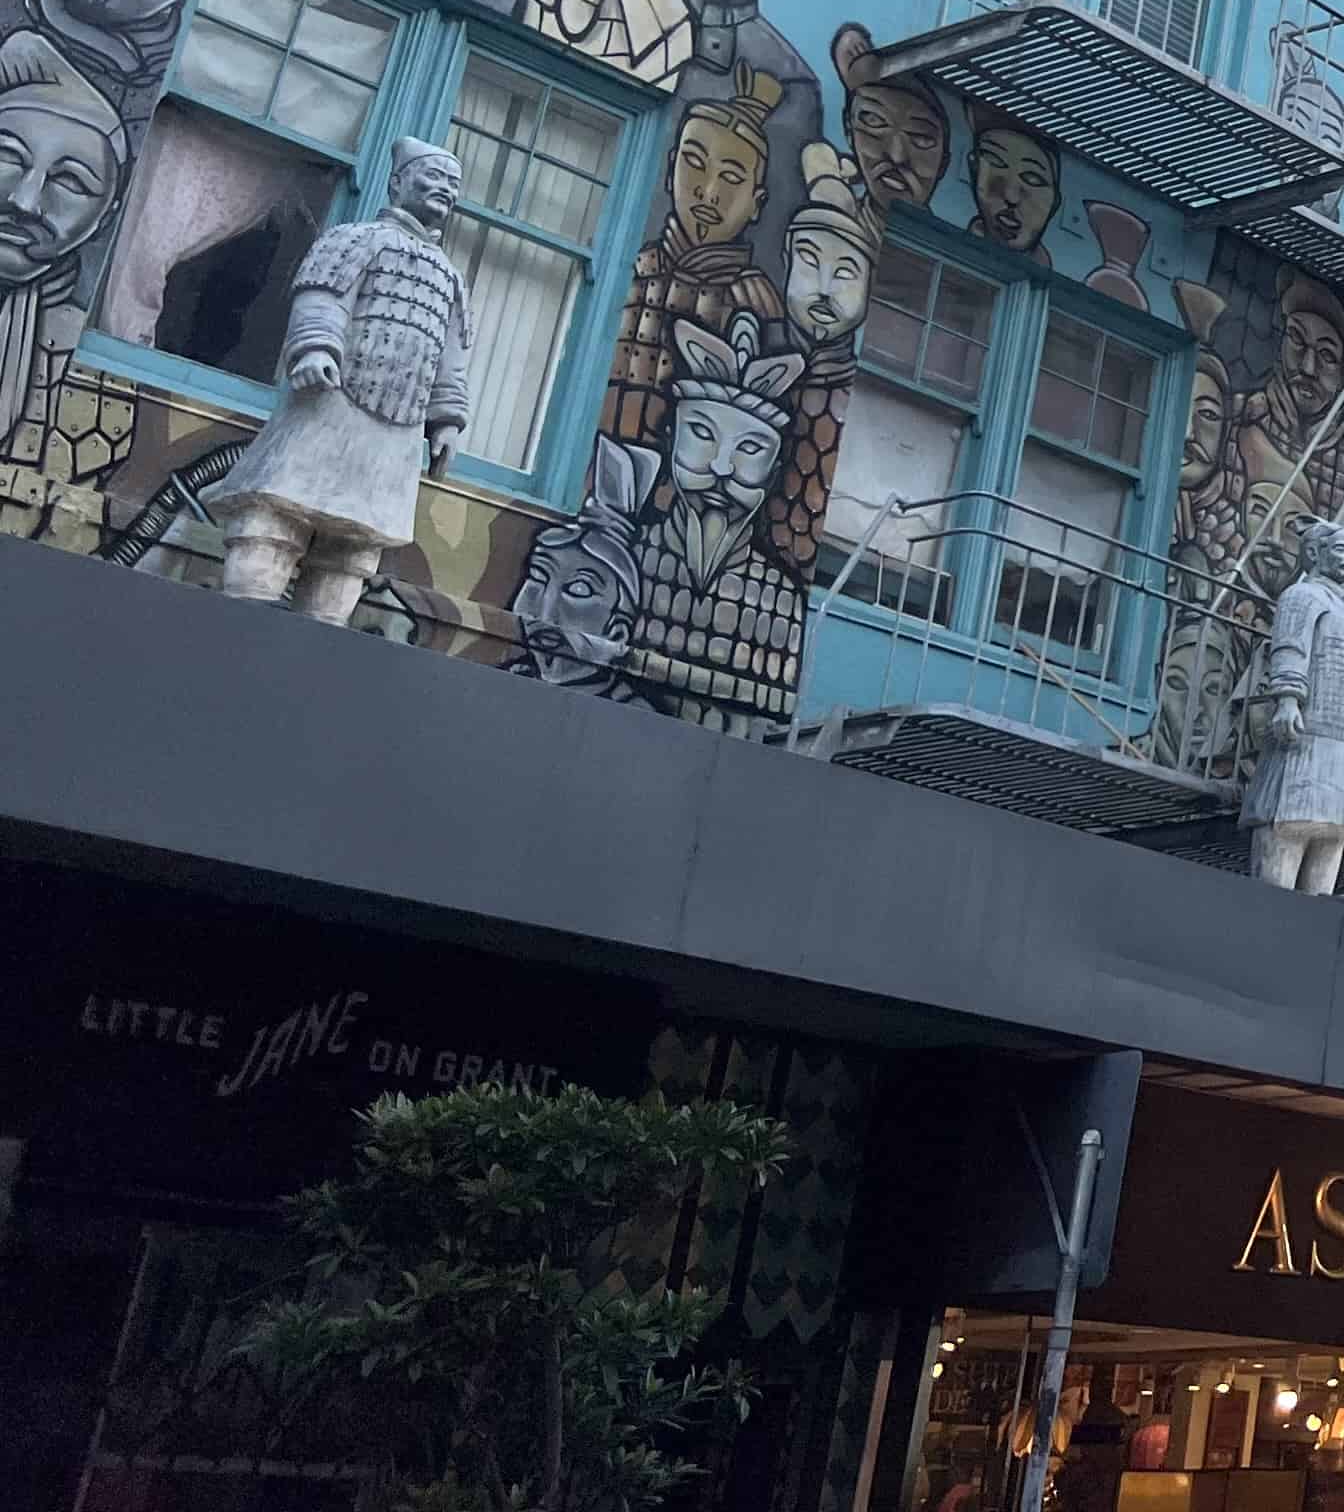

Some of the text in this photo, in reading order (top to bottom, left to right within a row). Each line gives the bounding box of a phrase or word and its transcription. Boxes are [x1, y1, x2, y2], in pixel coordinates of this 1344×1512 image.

[80, 993, 226, 1049] LITTLE
[215, 990, 369, 1098] JANE
[368, 1039, 422, 1078] ON
